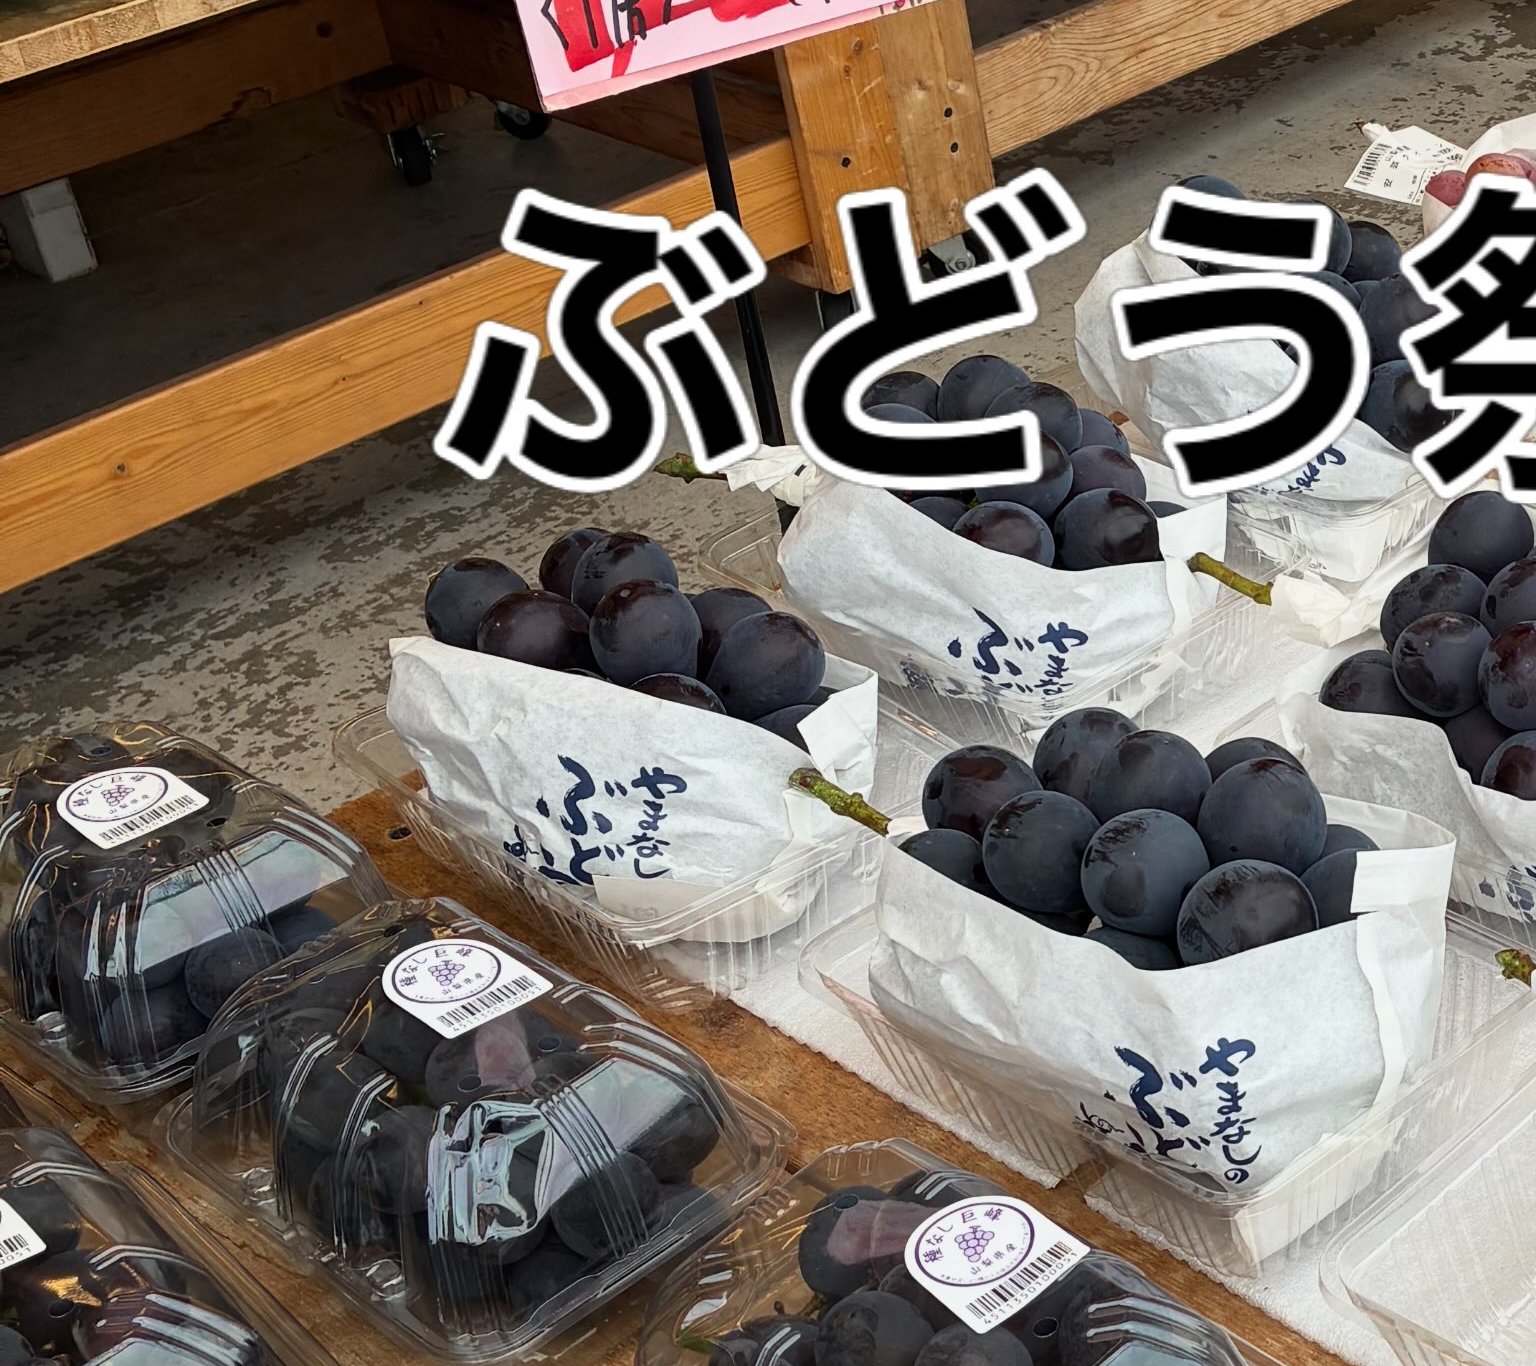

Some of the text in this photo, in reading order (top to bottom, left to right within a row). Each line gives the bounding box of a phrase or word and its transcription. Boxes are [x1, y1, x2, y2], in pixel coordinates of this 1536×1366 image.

[626, 766, 688, 879] やまなし
[1198, 1036, 1262, 1185] やまなしの
[922, 1206, 1004, 1264] 種なし巨峰
[969, 1242, 1018, 1276] 山梨県産
[982, 1251, 1079, 1325] 4511350100051
